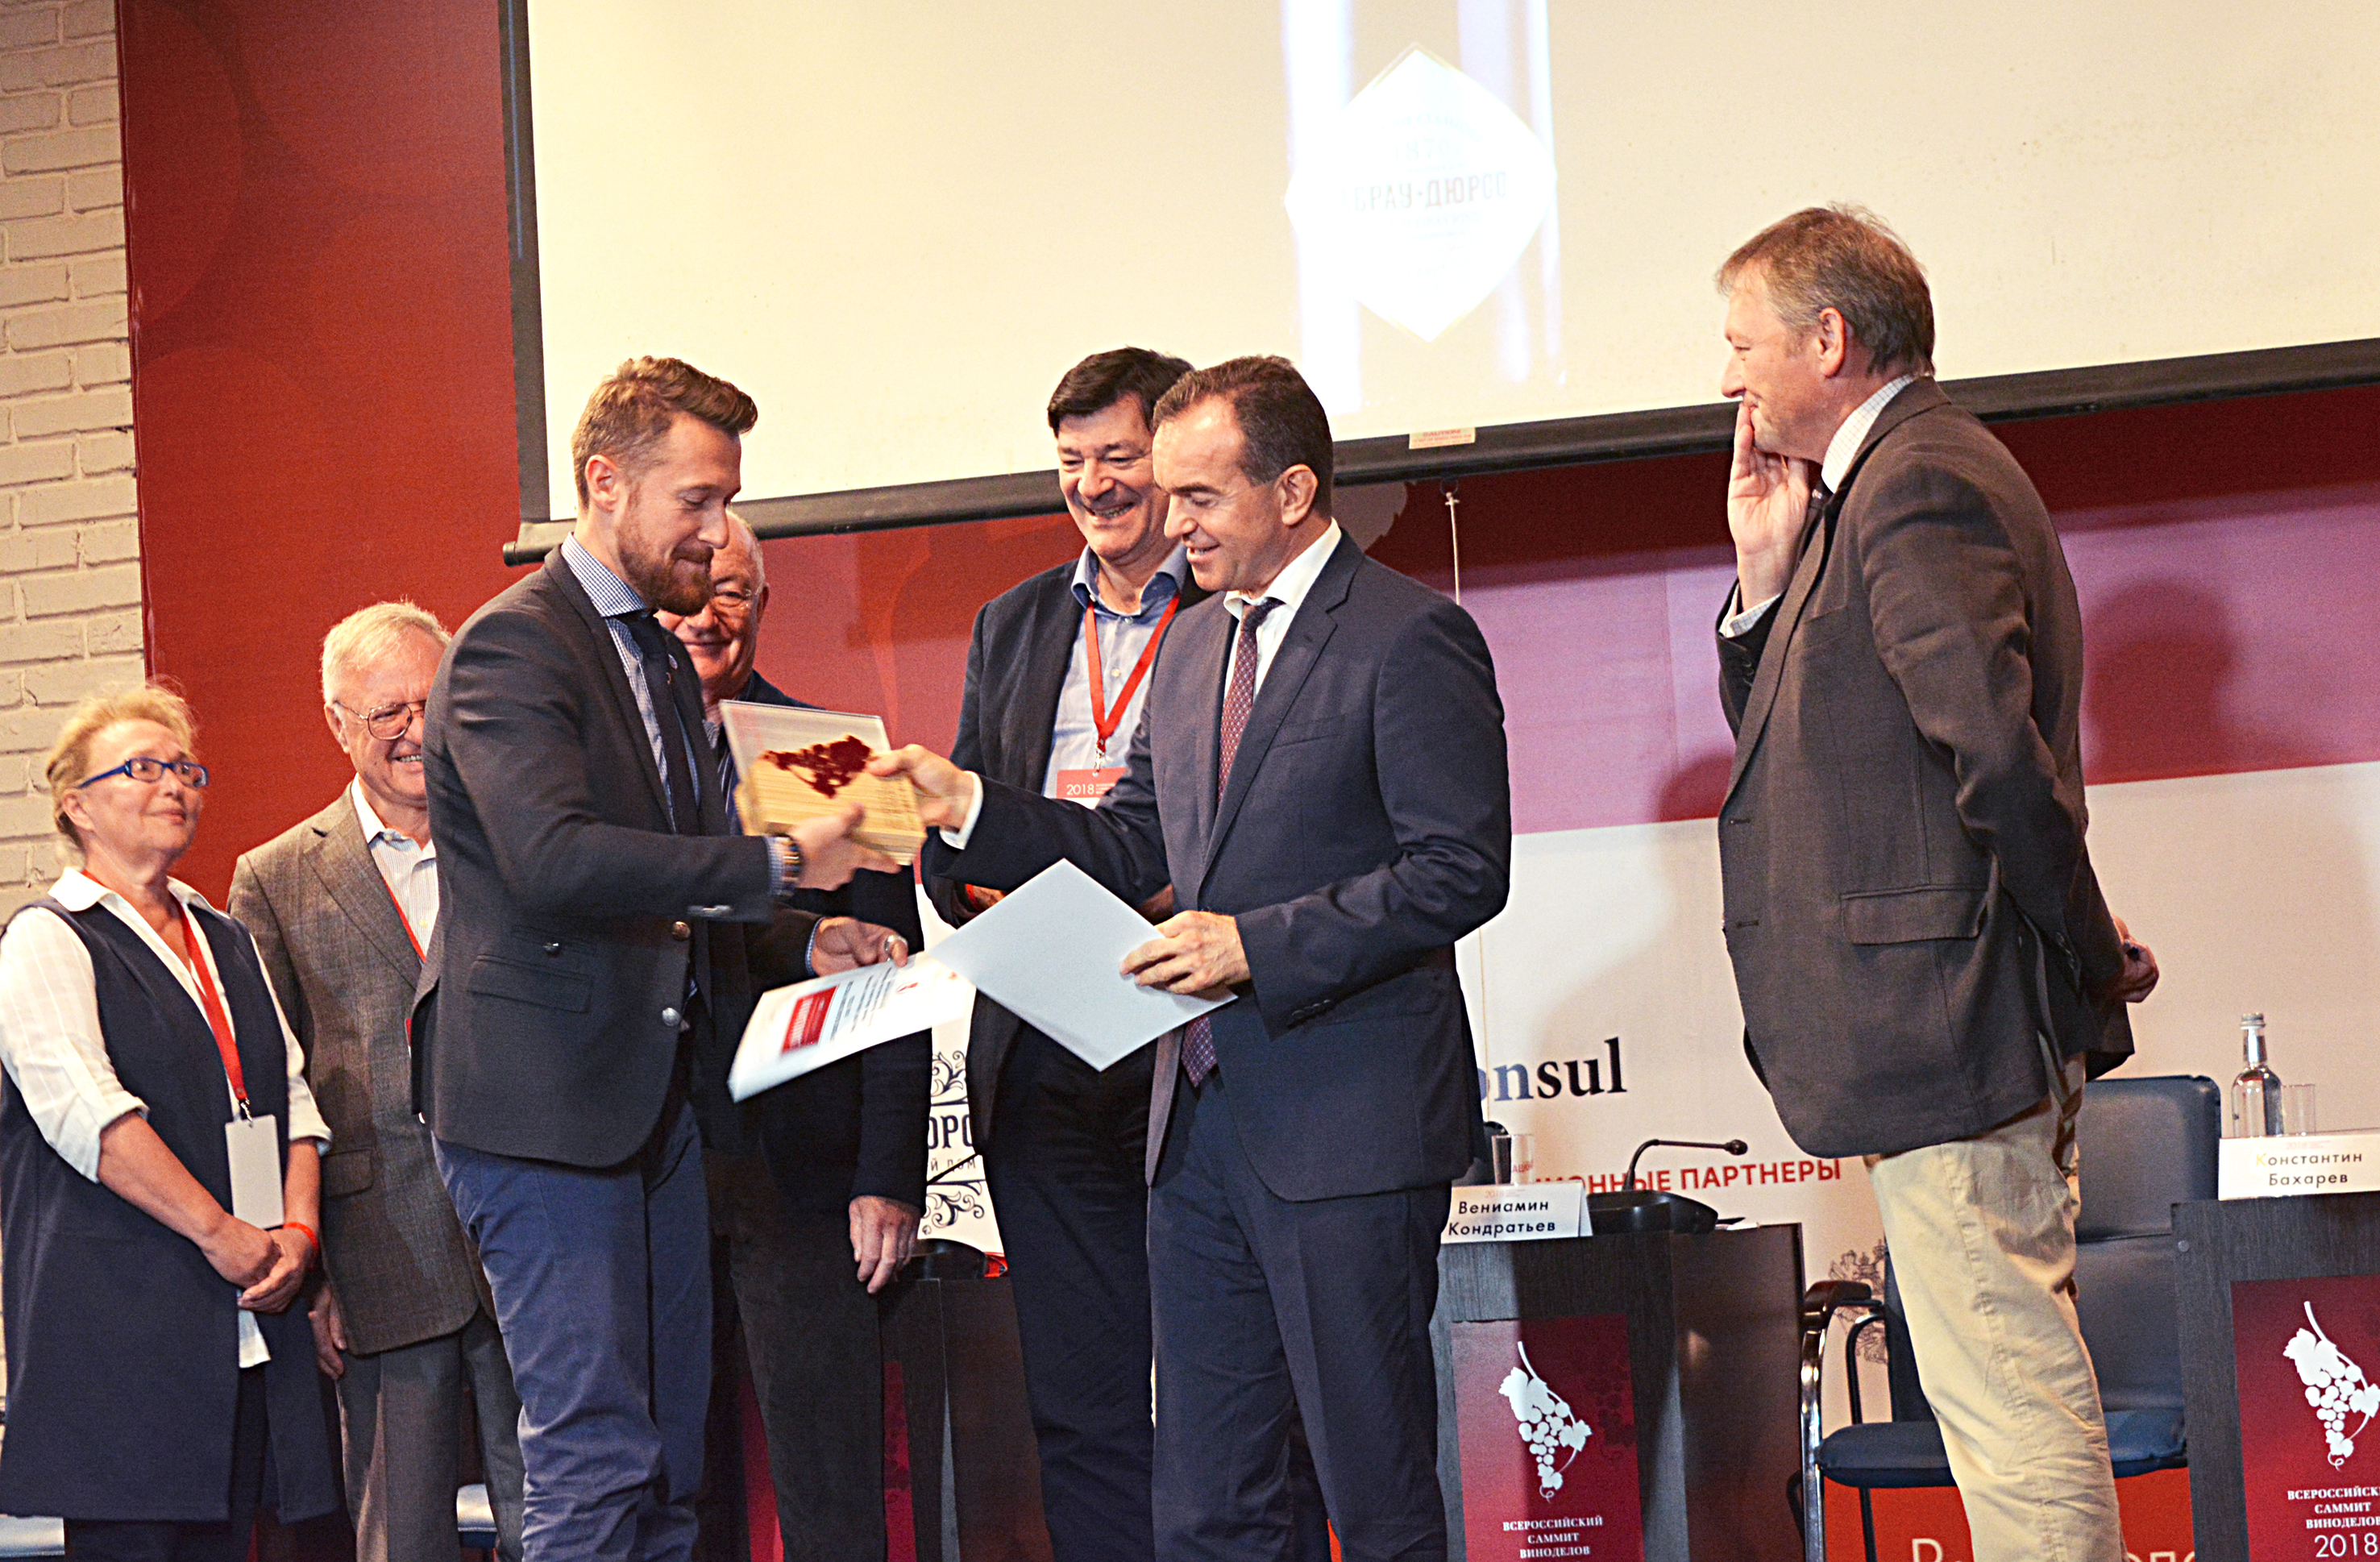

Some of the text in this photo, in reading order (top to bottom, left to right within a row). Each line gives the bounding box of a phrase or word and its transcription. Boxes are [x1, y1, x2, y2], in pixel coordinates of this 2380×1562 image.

[1066, 783, 1094, 796] 2018
[2256, 1153, 2362, 1166] Константин
[1680, 1158, 1841, 1190] ПАРТНЕРЫ
[2269, 1173, 2349, 1189] Бахарев
[1458, 1201, 1549, 1215] Вениамин
[1448, 1222, 1556, 1239] Кондратьев
[2287, 1485, 2380, 1500] ВСЕРОССИЙСК
[2314, 1502, 2372, 1514] САММИТ
[1502, 1515, 1604, 1531] ВСЕРОССИЙСКИЙ
[1527, 1532, 1580, 1544] САММИТ
[2314, 1532, 2378, 1558] 2018
[1519, 1546, 1591, 1559] ВИНОДЕЛОВ
